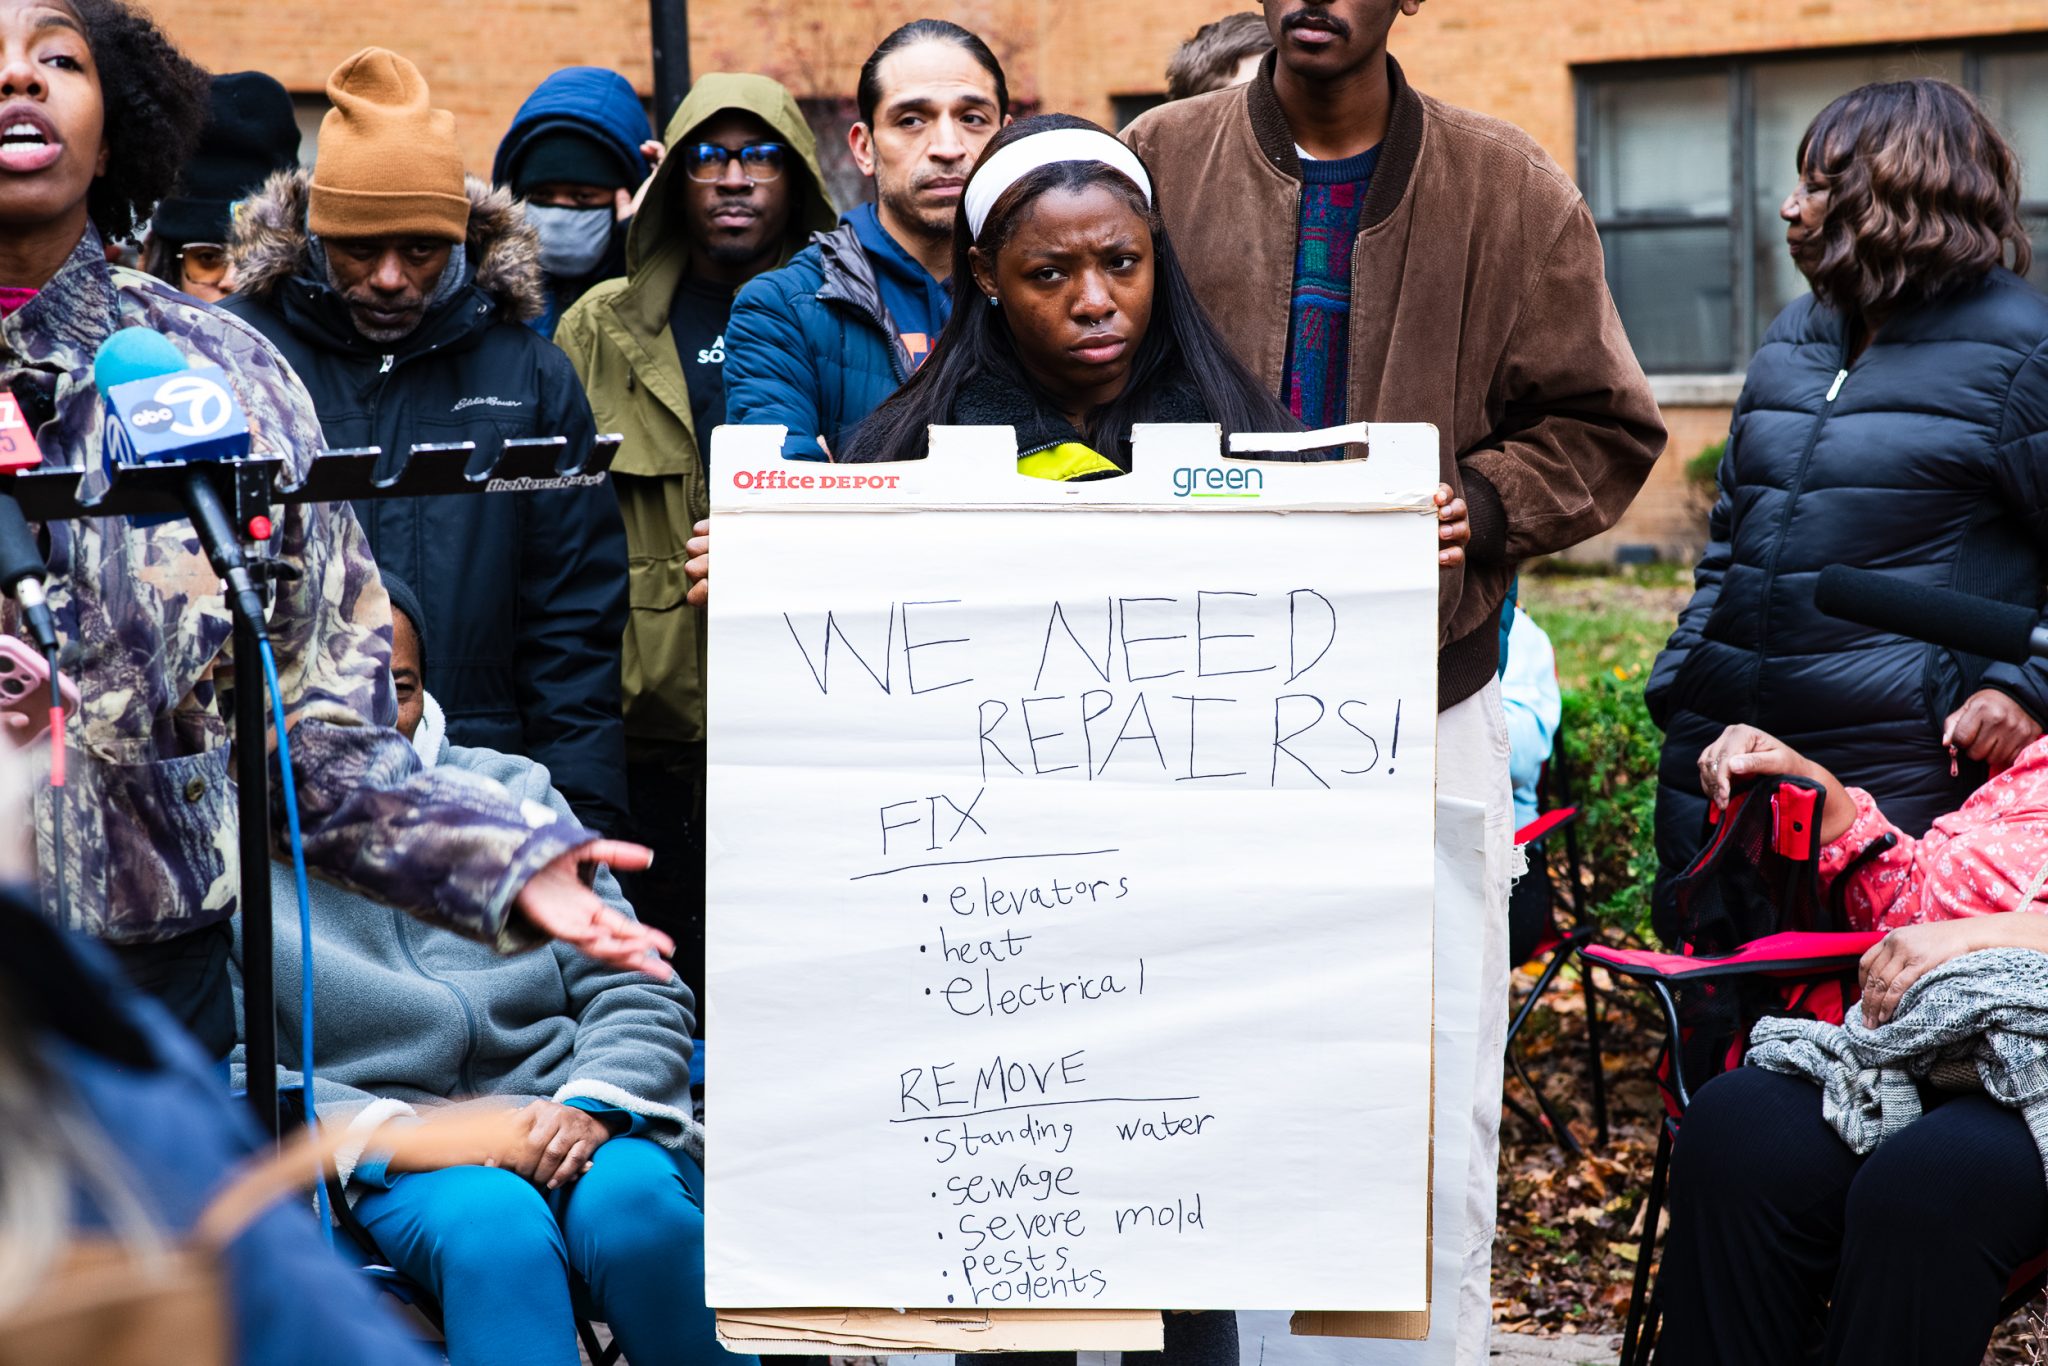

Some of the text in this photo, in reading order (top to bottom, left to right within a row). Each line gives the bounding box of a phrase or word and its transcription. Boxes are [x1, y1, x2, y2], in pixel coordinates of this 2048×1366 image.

[131, 407, 174, 427] abc
[733, 470, 900, 489] Office DEPOT
[1173, 467, 1263, 497] green
[784, 588, 1337, 696] WE NEED
[978, 690, 1402, 789] REPAIRS!
[880, 787, 987, 855] FIX
[949, 877, 1129, 917] elevators
[940, 926, 1033, 964] heat
[940, 958, 1145, 1017] electrical
[900, 1049, 1087, 1113] REMOVE
[1116, 1111, 1215, 1141] water
[1116, 1193, 1205, 1235] mold
[962, 1244, 1070, 1287] pests
[970, 1268, 1107, 1305] rodents
